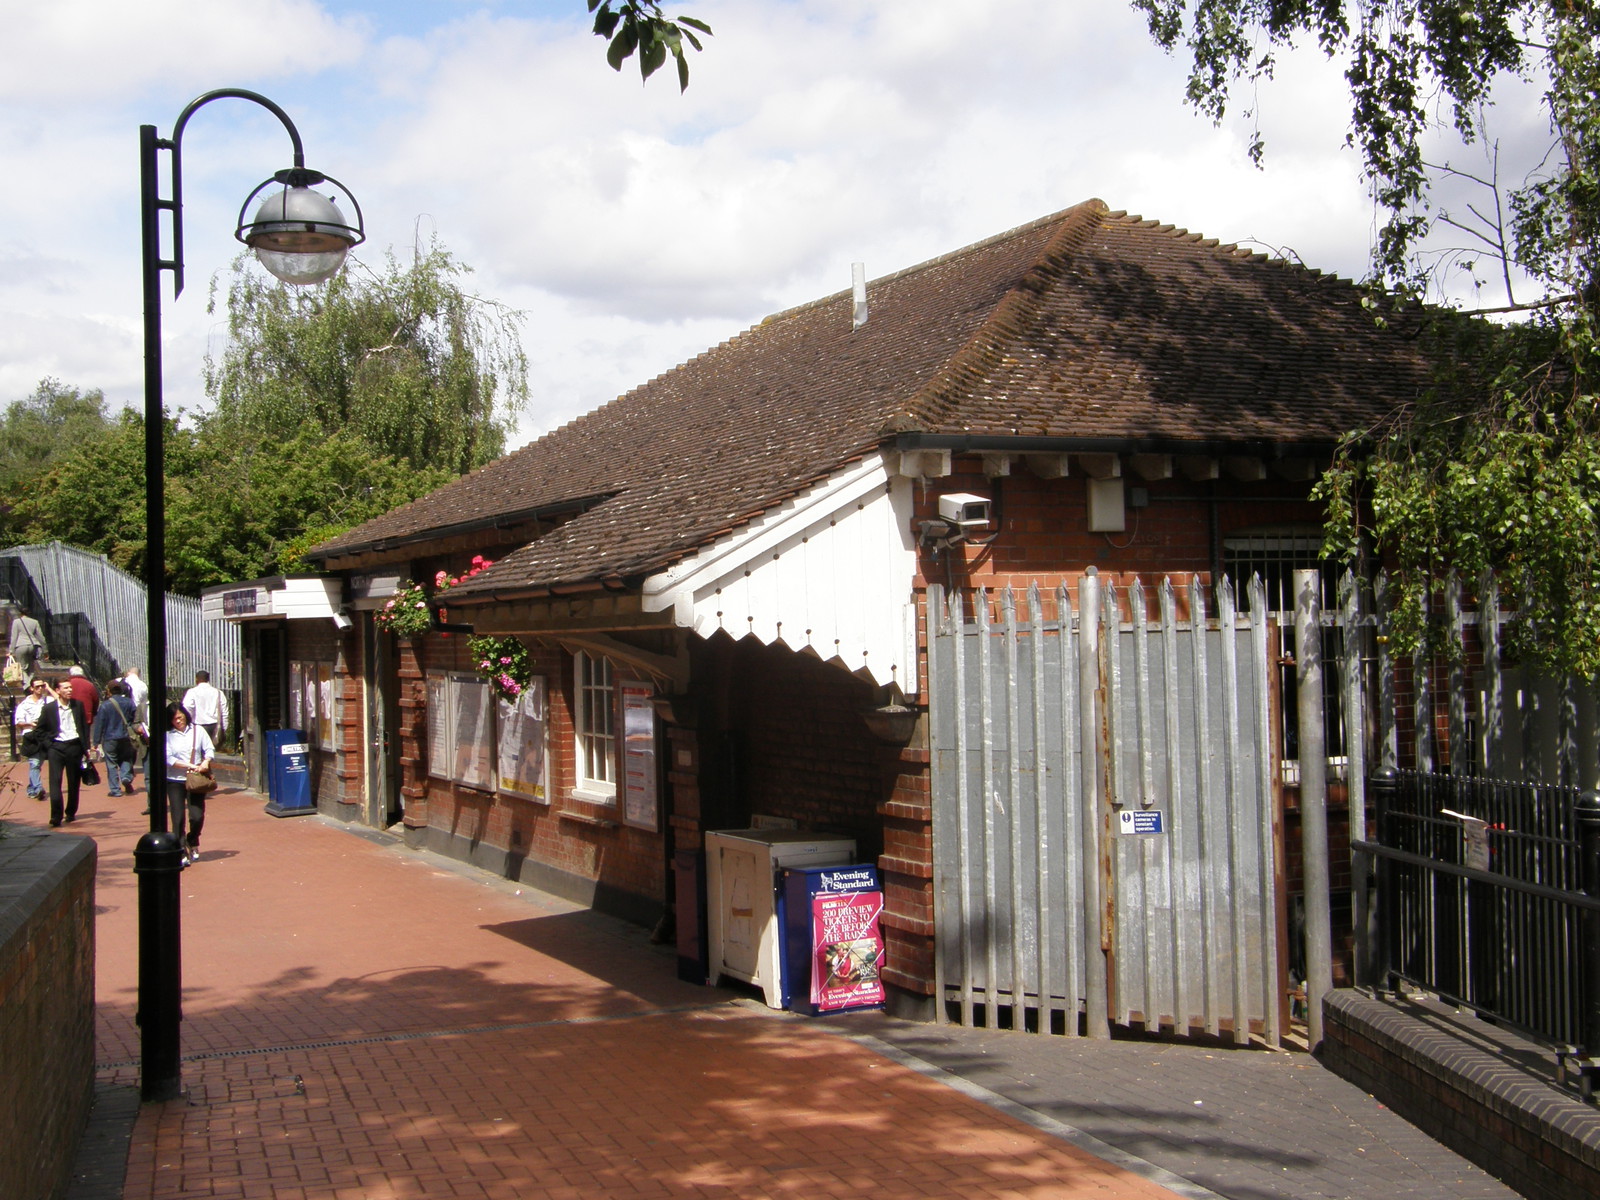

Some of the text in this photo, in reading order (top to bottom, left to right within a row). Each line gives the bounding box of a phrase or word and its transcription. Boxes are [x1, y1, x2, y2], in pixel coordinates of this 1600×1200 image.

[833, 871, 869, 881] Evening
[833, 878, 874, 890] Standard
[822, 909, 836, 919] 200
[838, 904, 874, 916] PREVIEW
[822, 913, 870, 925] TICKETS TO
[824, 932, 842, 943] THE
[852, 986, 880, 996] Standard
